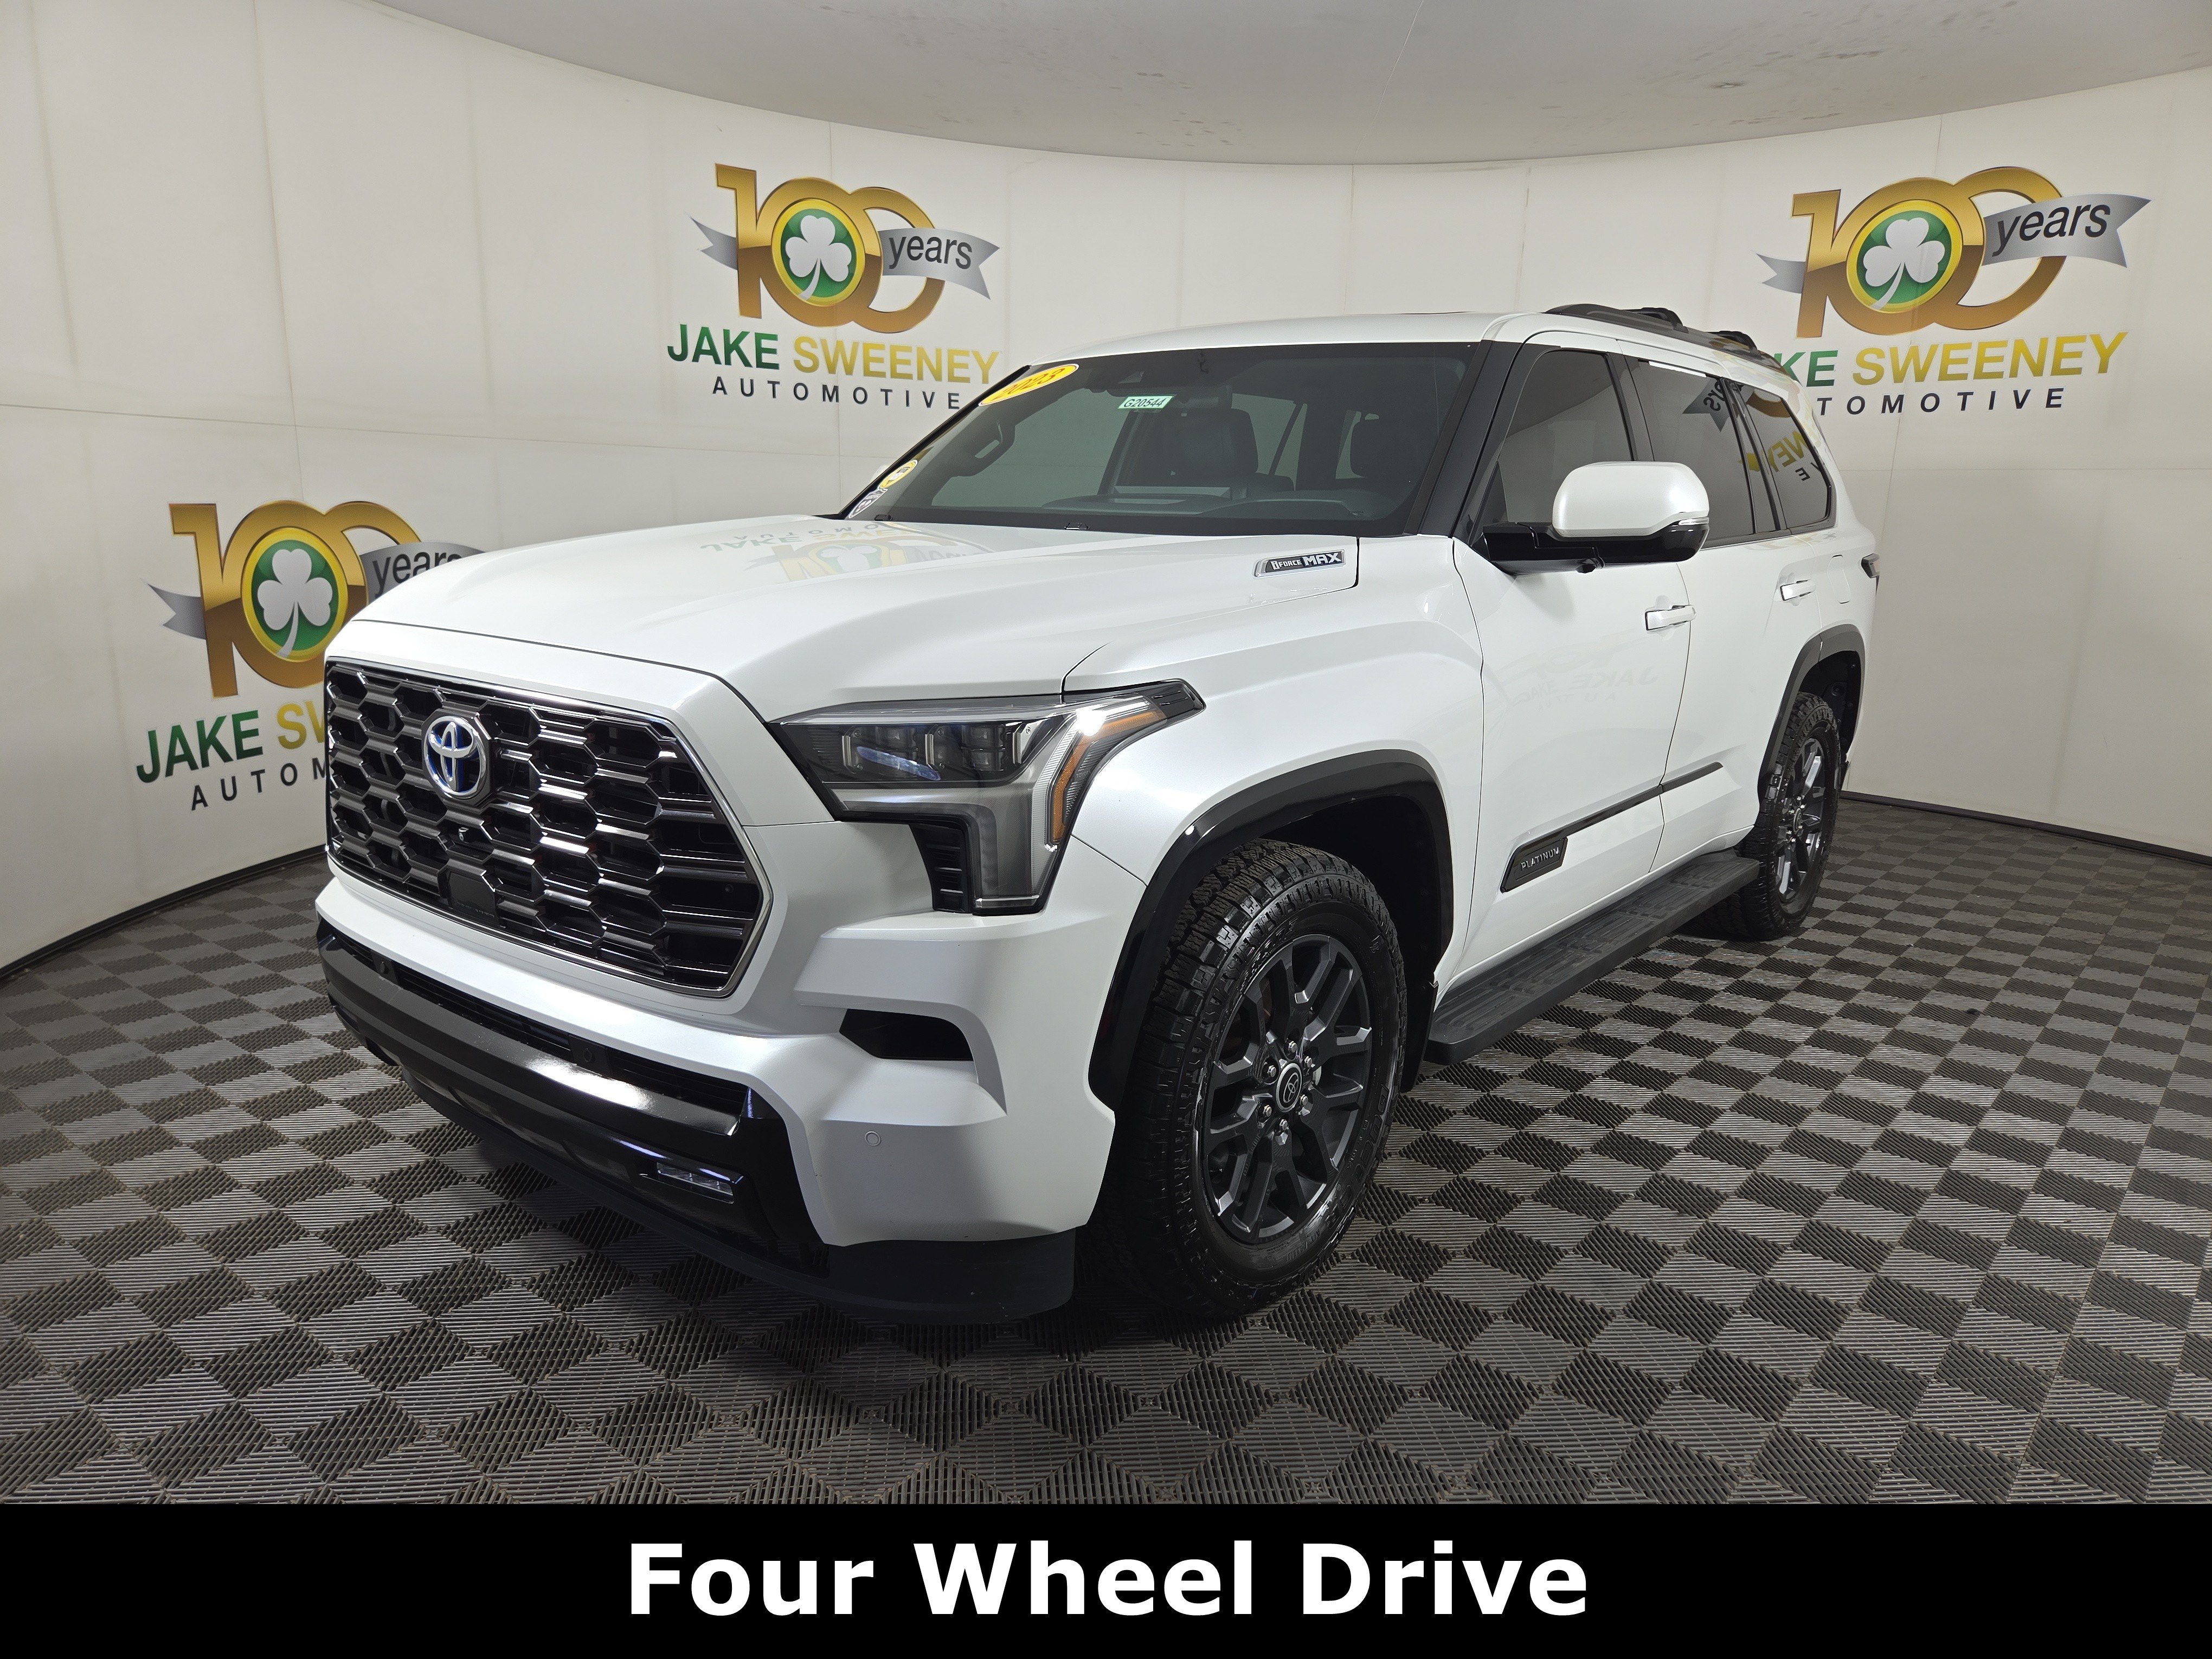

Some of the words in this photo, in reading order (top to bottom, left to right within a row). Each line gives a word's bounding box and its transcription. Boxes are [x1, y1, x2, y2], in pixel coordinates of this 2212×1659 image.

[1992, 204, 2111, 257] years
[889, 235, 973, 270] years
[667, 323, 780, 370] JAKE
[793, 336, 1000, 384] SWEENEY
[1774, 350, 1838, 387] KE
[1852, 331, 2129, 385] SWEENEY
[712, 376, 960, 409] AUTOMOTIVE
[994, 368, 1066, 401] 2023
[1124, 398, 1165, 408] G20544
[1817, 388, 2065, 416] TOMOTIVE
[1302, 552, 1341, 567] MAX
[136, 710, 263, 783] JAKE
[1520, 847, 1560, 871] PLATINUM
